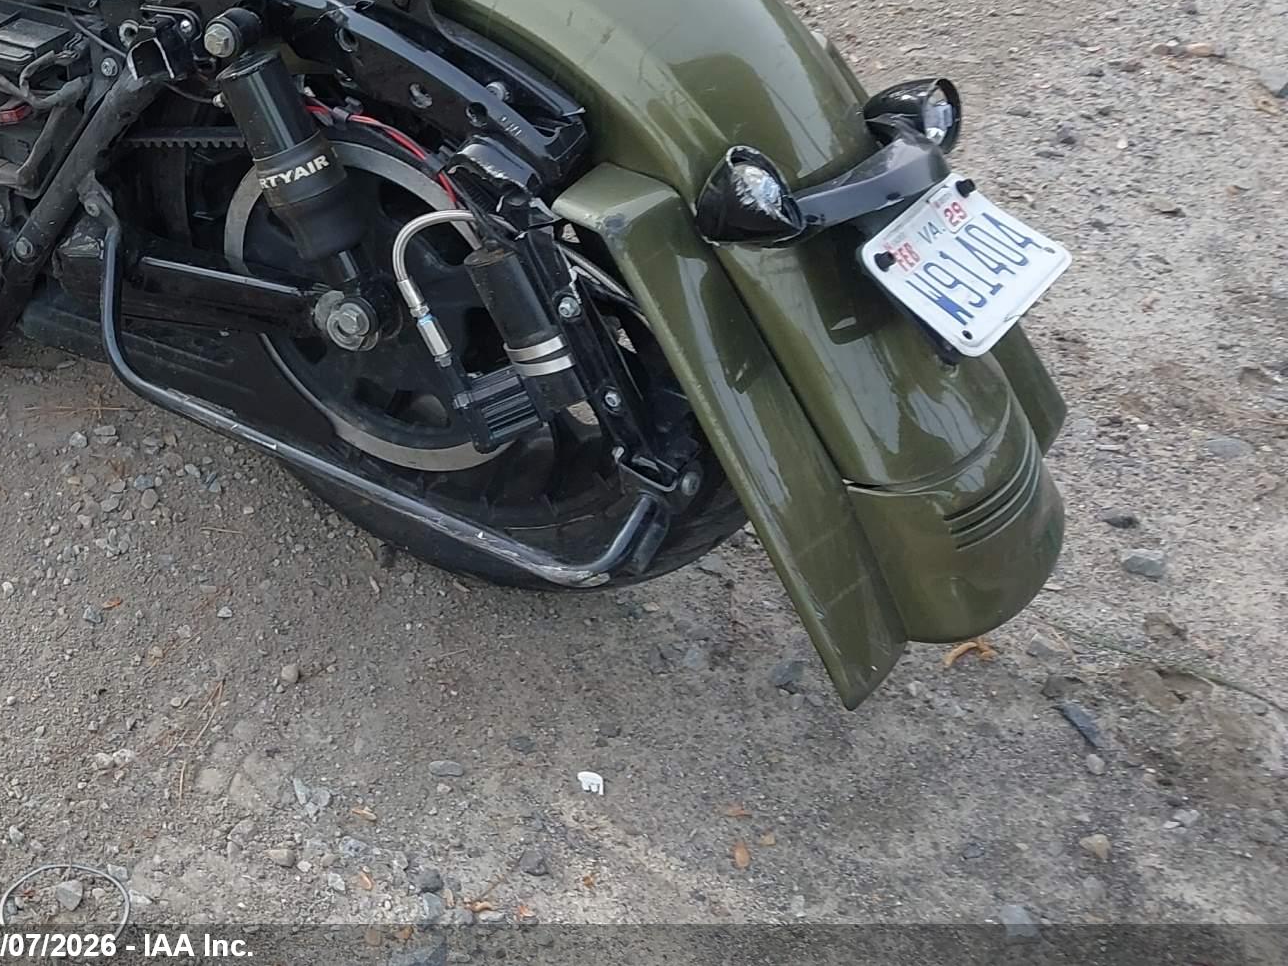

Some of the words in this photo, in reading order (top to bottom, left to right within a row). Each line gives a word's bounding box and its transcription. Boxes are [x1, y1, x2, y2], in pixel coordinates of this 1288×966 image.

[944, 202, 968, 227] 29
[894, 242, 920, 272] FEB
[906, 212, 1043, 326] W91404
